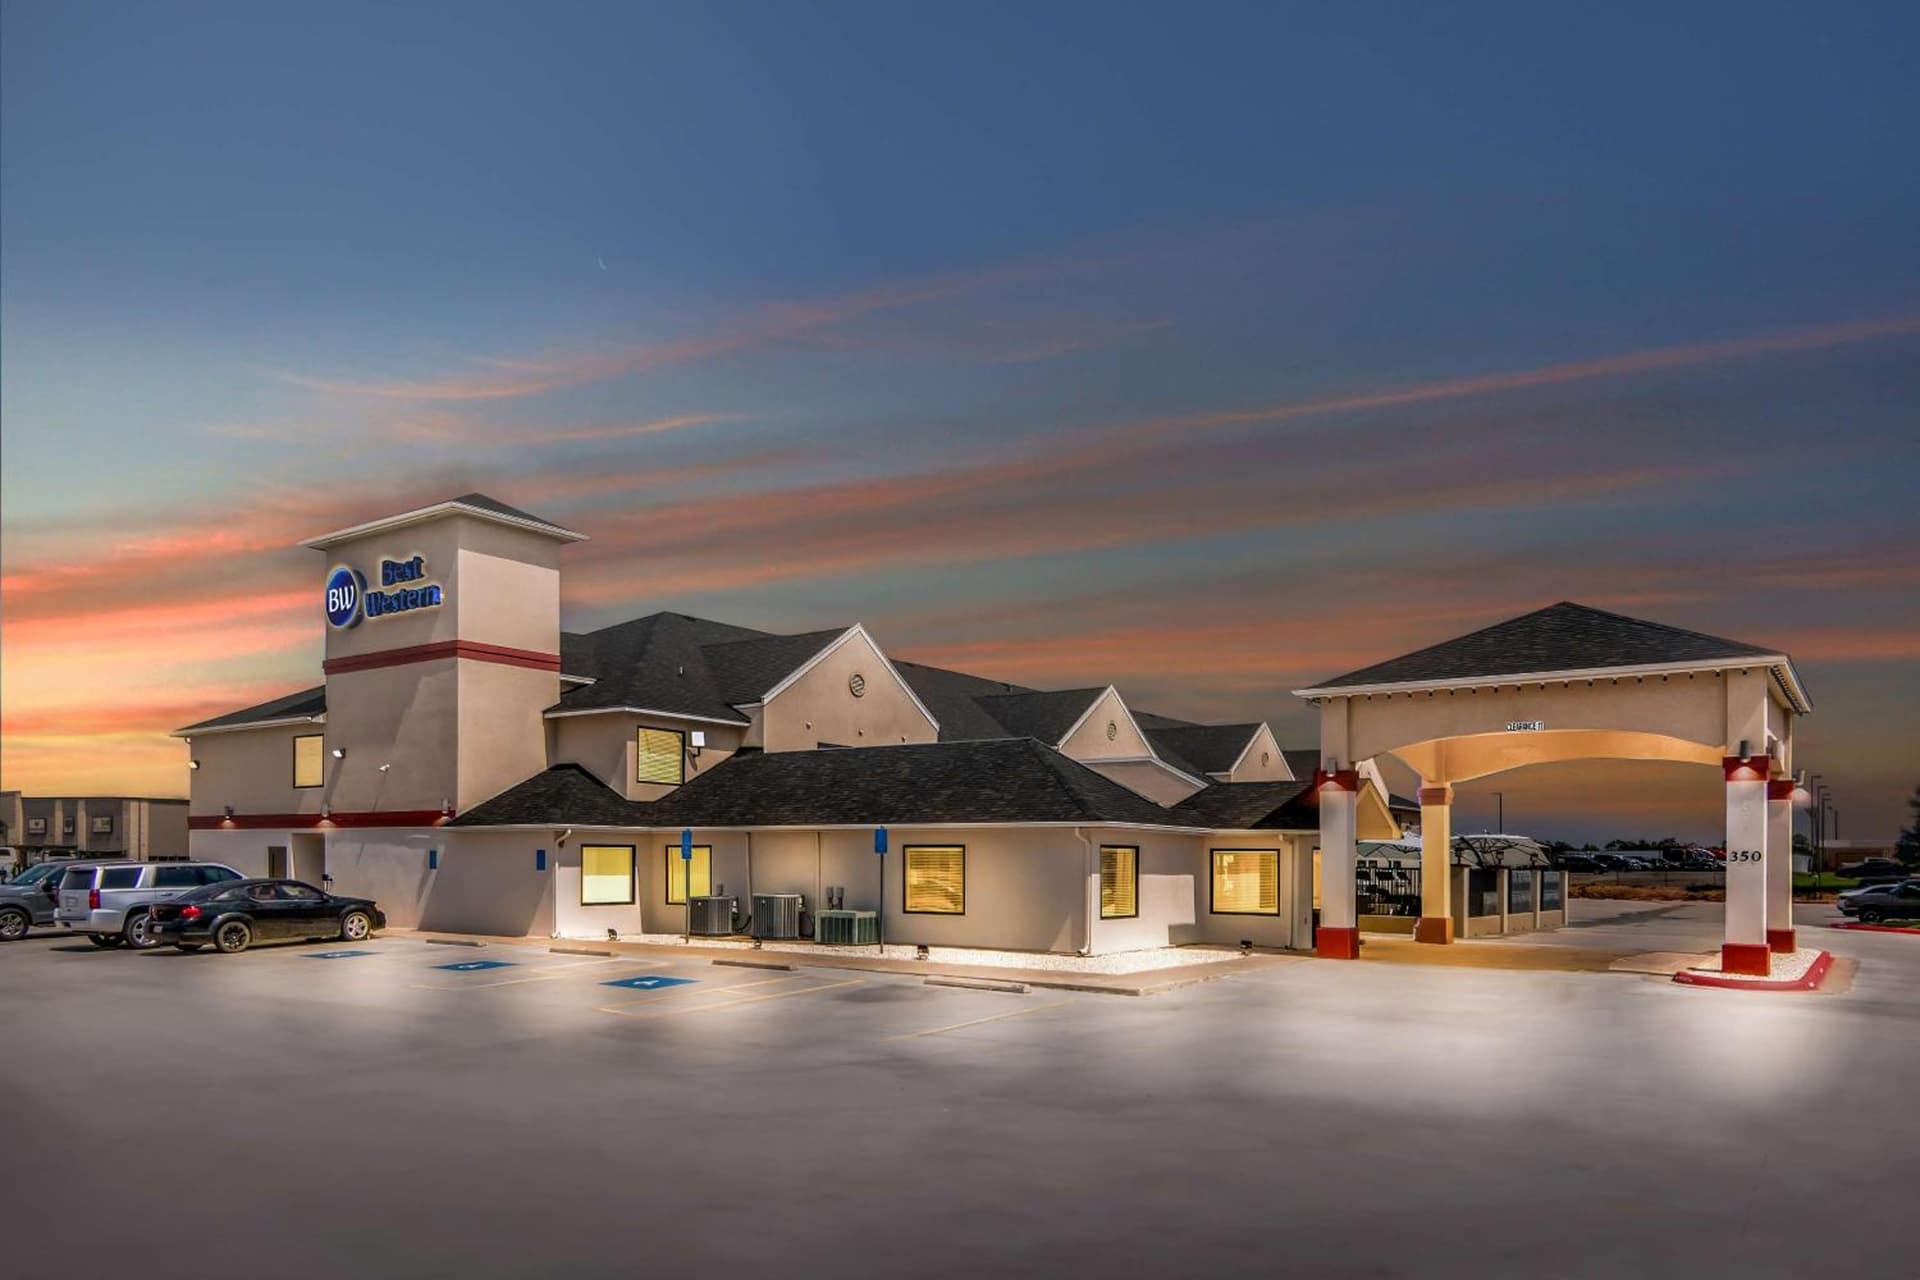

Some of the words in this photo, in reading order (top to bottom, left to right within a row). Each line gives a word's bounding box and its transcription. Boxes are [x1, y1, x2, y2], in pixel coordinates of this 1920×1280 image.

[382, 556, 424, 586] Best
[329, 585, 354, 612] BW
[365, 585, 441, 617] Western
[1729, 850, 1762, 862] 350
